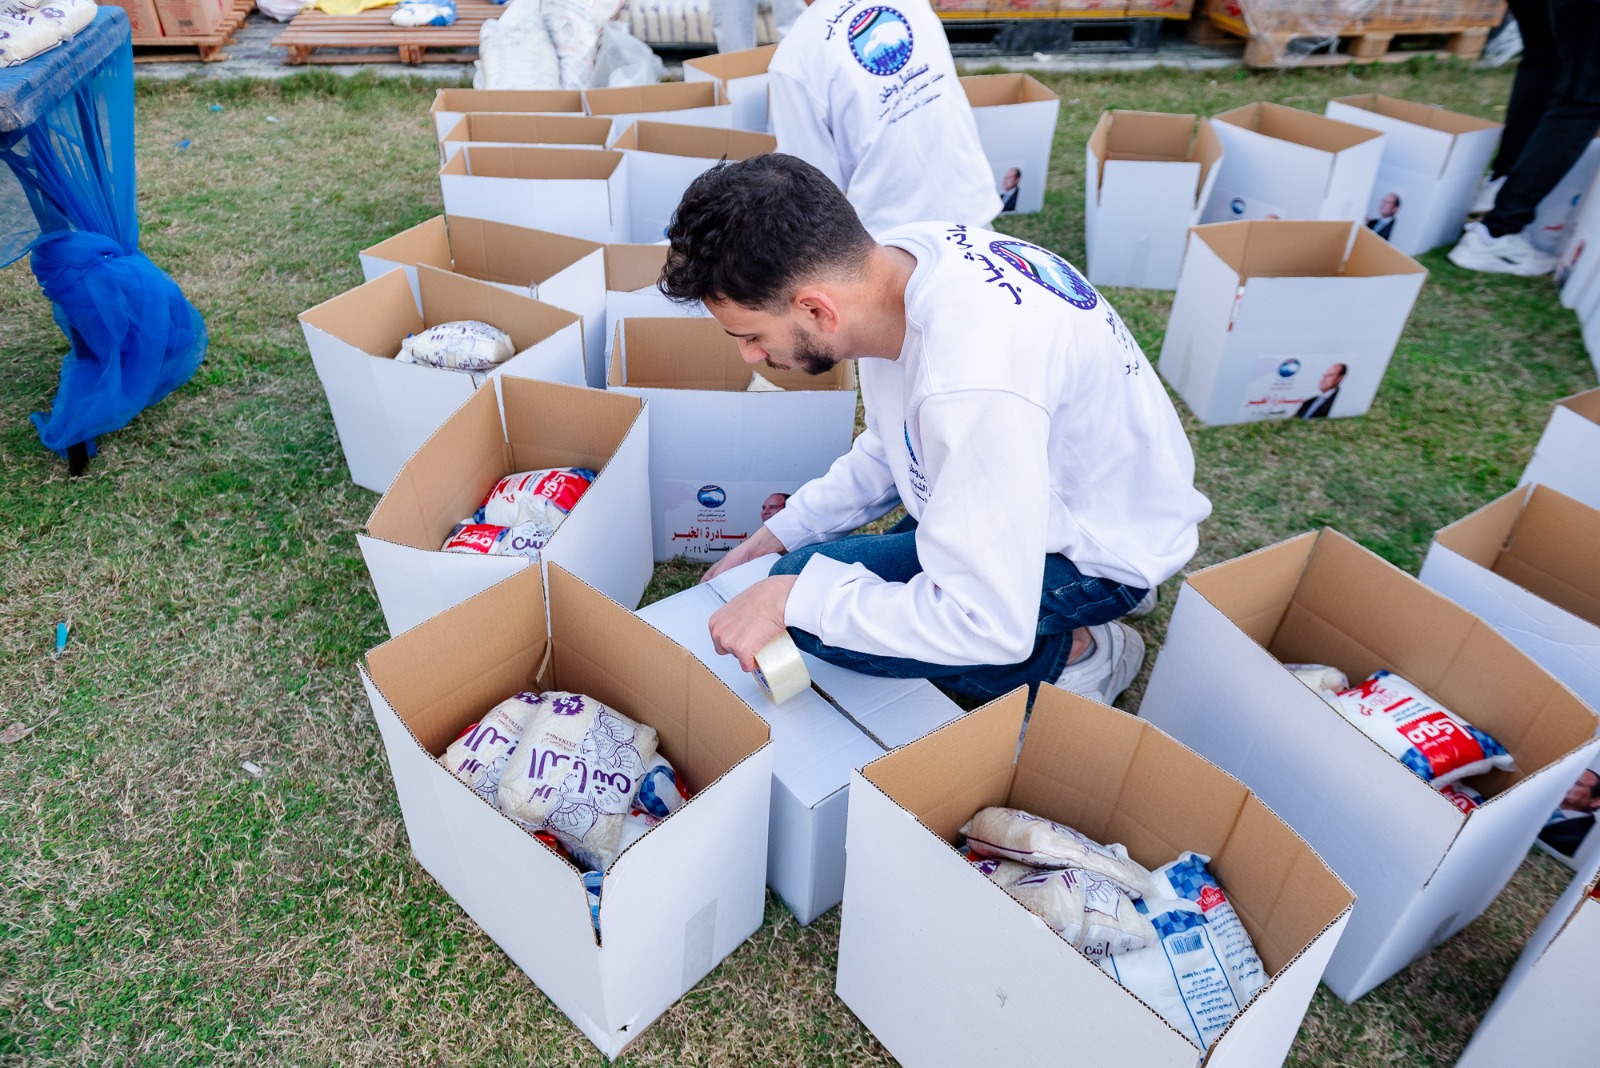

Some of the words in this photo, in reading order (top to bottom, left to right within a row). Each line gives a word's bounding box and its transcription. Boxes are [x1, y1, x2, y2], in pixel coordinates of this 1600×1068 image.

[671, 525, 703, 542] الخير
[705, 526, 748, 543] مبادرة
[1406, 717, 1474, 745] موكا
[528, 747, 631, 794] الدياش
